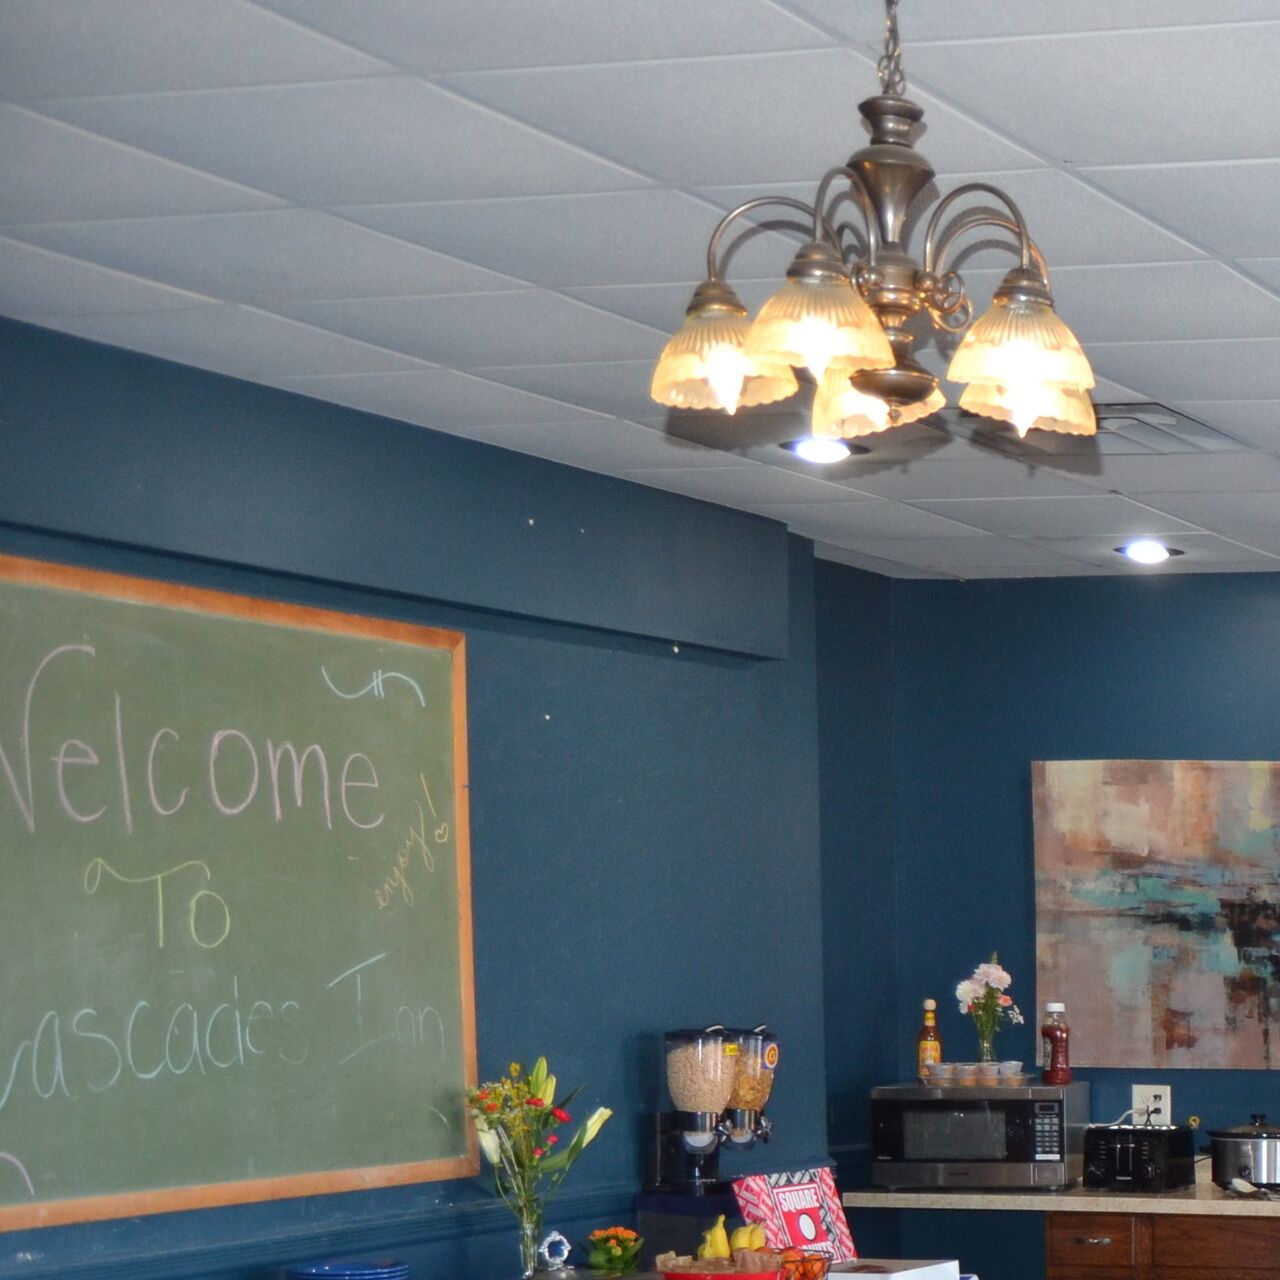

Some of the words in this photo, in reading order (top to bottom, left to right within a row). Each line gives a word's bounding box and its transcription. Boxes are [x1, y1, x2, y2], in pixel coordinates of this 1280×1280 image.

[0, 975, 308, 1108] ascades
[327, 952, 446, 1066] Inn
[778, 1189, 820, 1212] SQUARE
